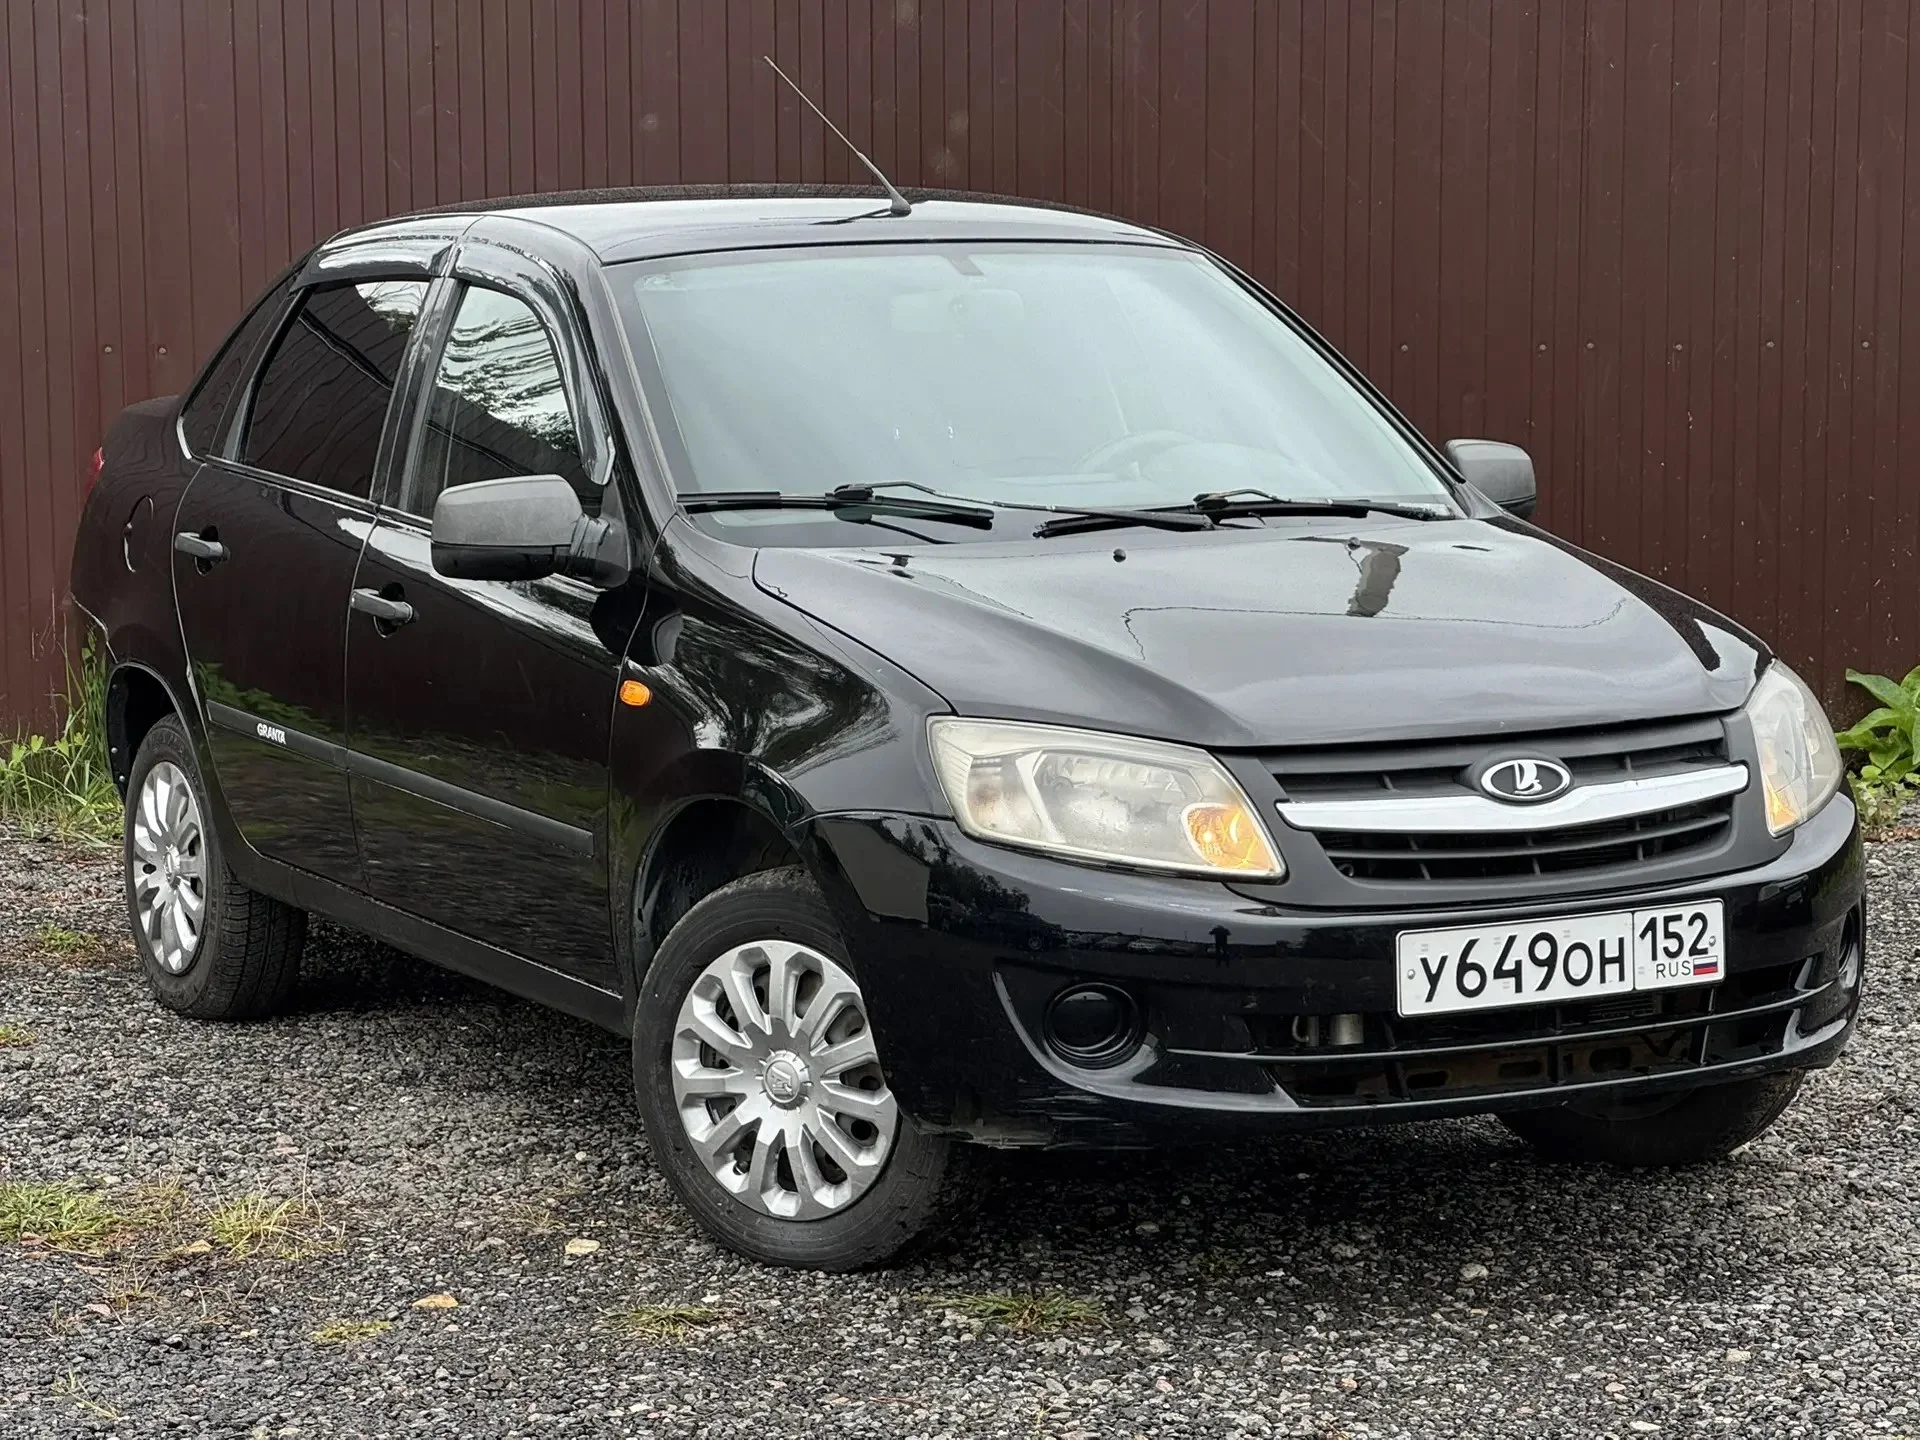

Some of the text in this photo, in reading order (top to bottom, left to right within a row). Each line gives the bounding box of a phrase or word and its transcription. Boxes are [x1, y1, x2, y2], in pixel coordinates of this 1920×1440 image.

[256, 722, 287, 745] GRANTA
[1638, 911, 1709, 962] 152
[1655, 960, 1692, 980] RUS
